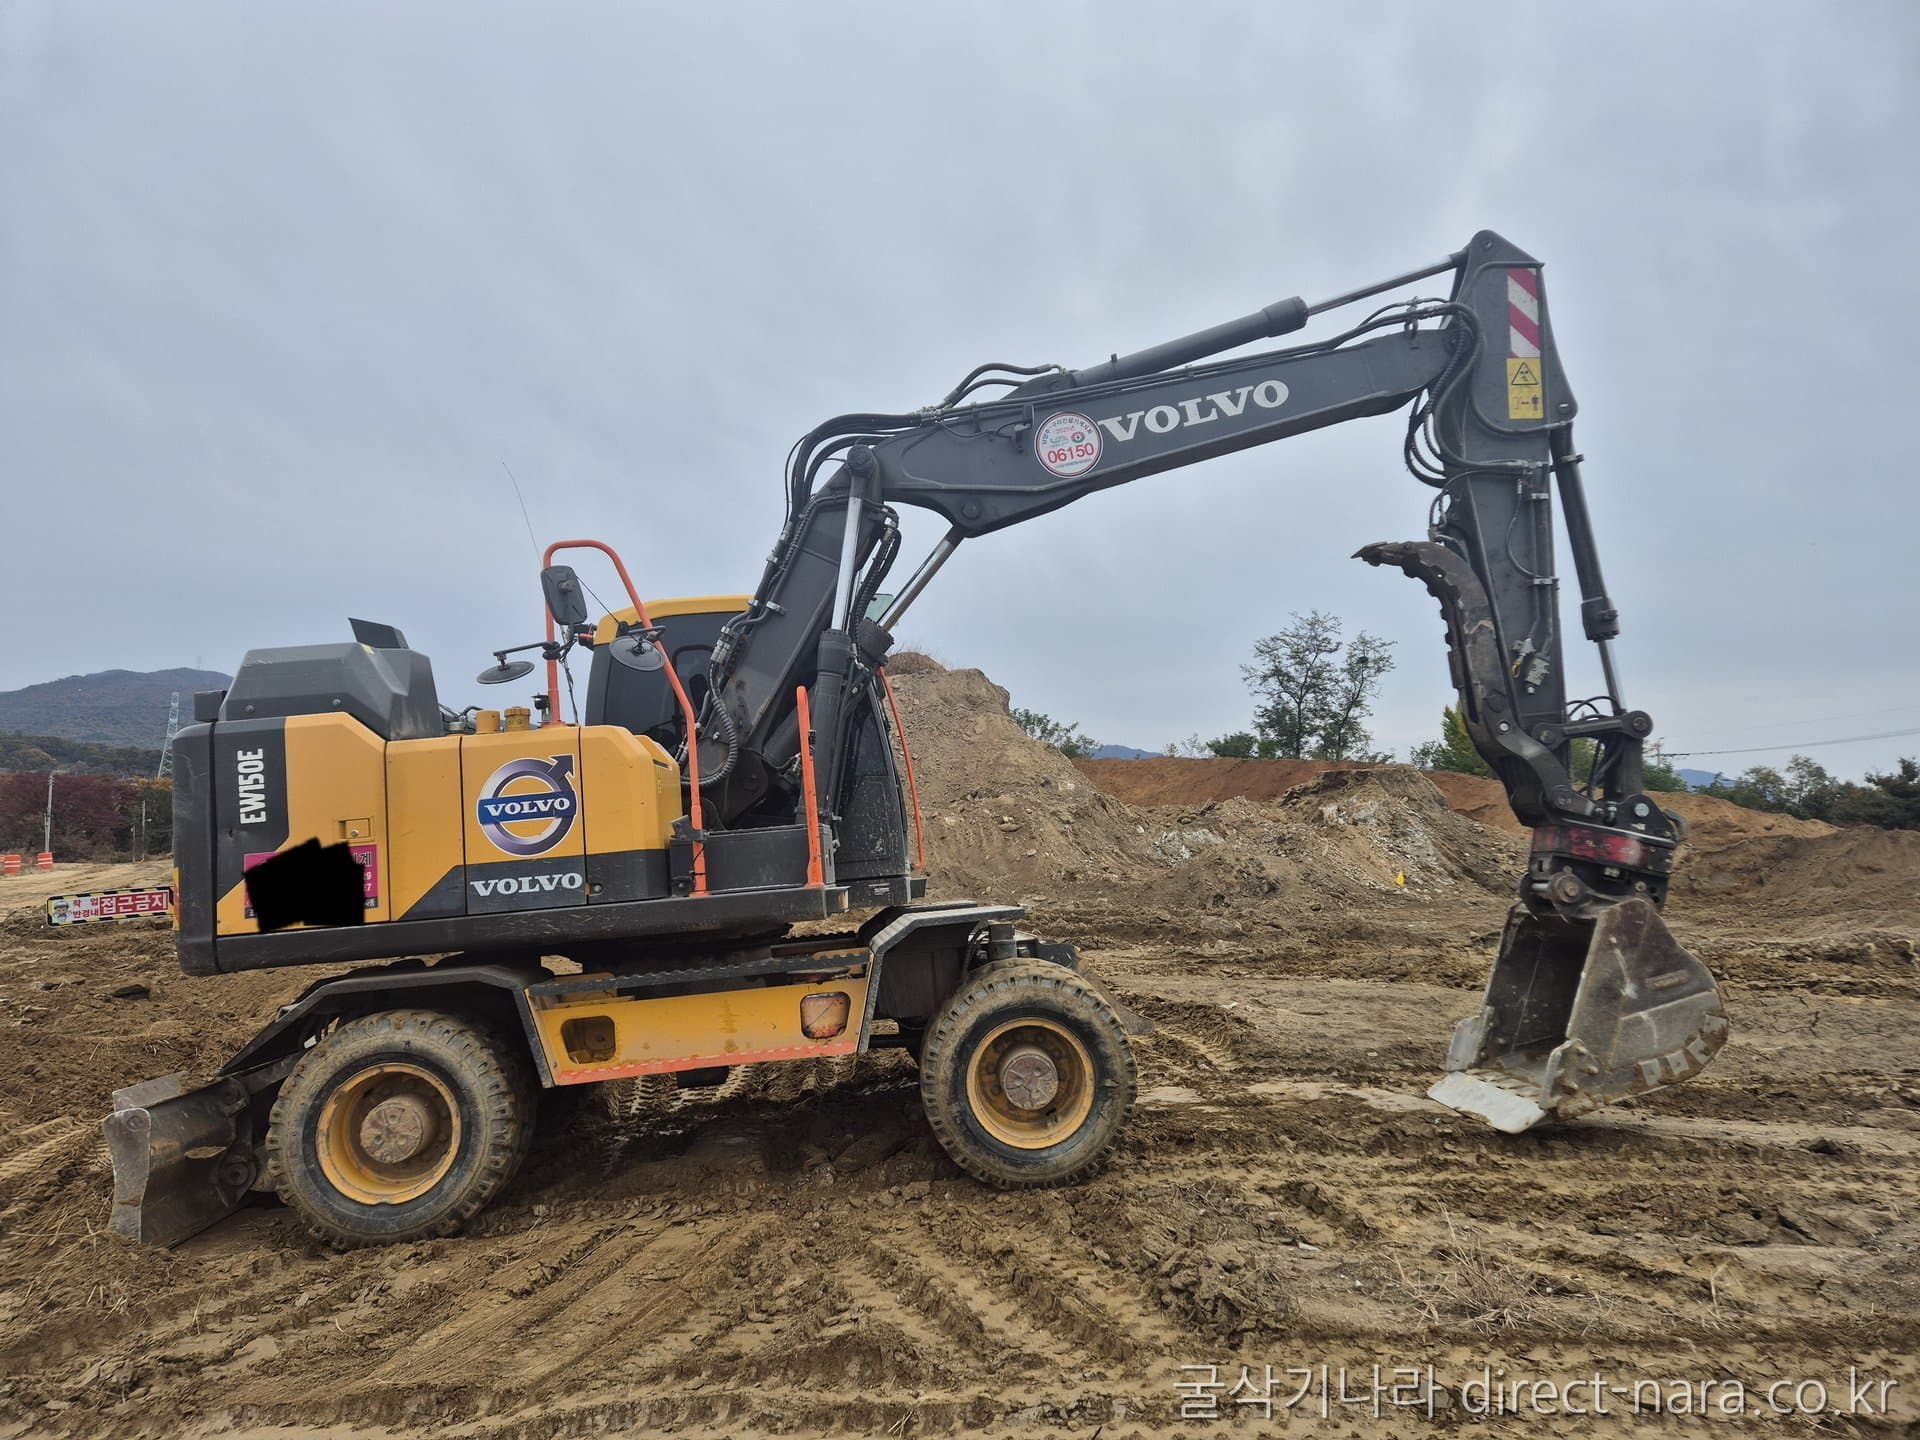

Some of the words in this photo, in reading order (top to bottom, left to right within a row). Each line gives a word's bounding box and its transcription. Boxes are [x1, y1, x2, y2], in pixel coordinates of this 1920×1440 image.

[1097, 380, 1289, 442] VOLVO
[1047, 442, 1095, 464] 06150
[237, 748, 267, 825] EW150E
[484, 797, 570, 817] VOLVO
[470, 872, 583, 897] VOLVO
[72, 908, 99, 919] 반경내
[101, 892, 167, 914] 접근금지
